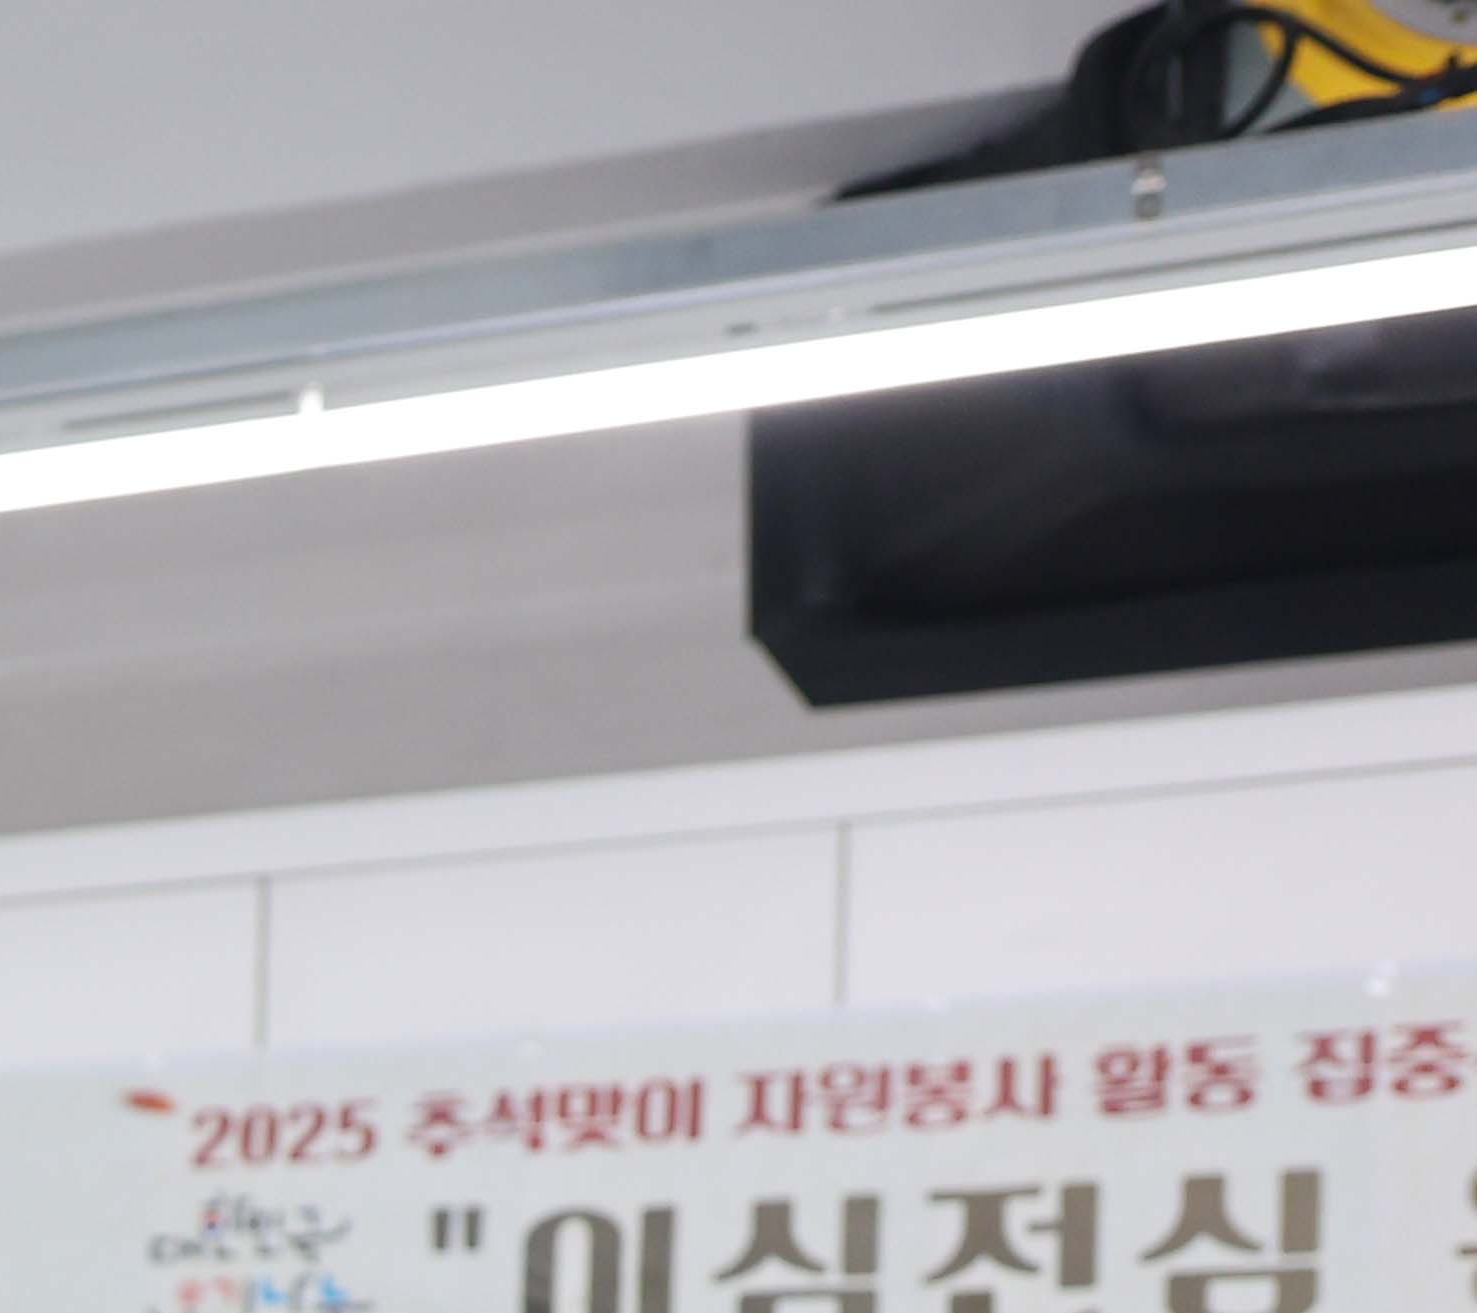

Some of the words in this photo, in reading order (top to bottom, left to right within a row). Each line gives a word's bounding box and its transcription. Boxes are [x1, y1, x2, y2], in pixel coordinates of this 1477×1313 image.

[192, 1098, 378, 1168] 2025
[406, 1078, 707, 1158] 추석맞이
[736, 1051, 1060, 1135] 자원봉사
[1091, 1036, 1262, 1113] 활동
[1297, 1020, 1470, 1104] 집중
